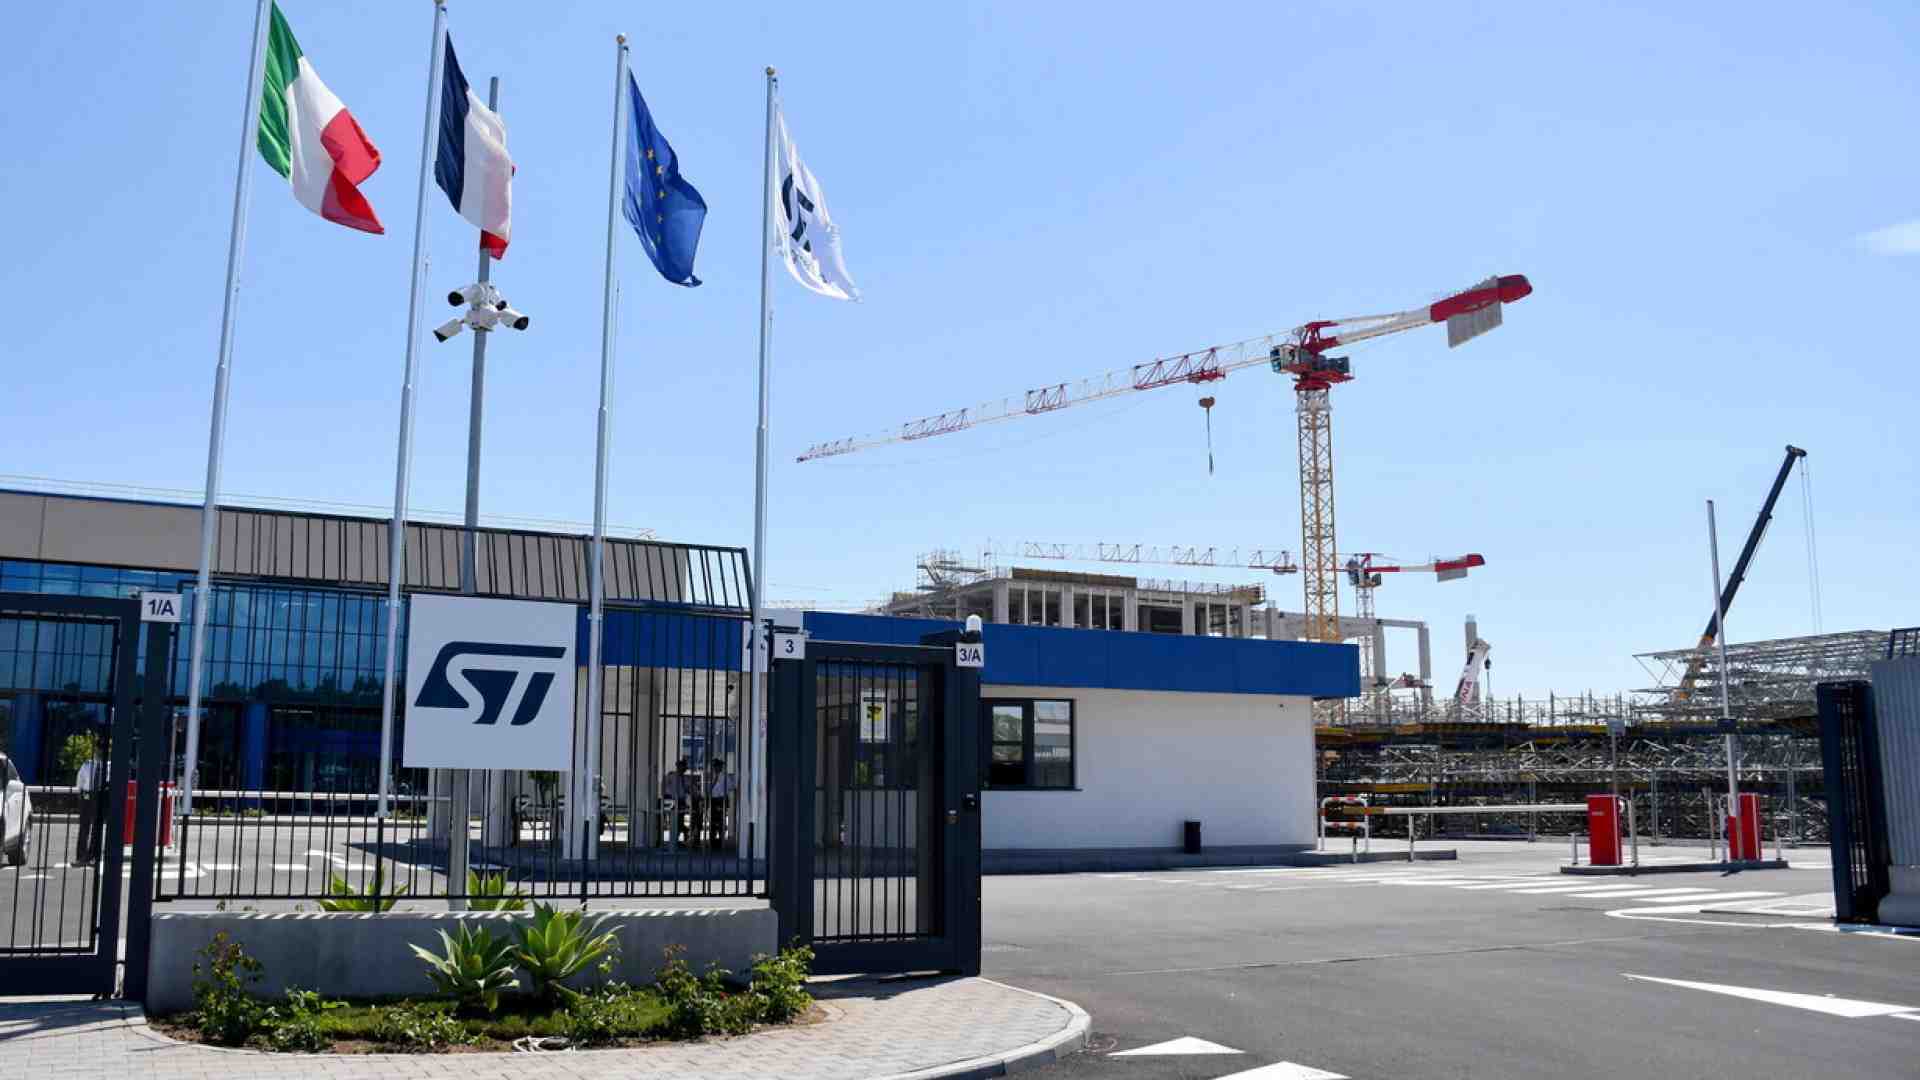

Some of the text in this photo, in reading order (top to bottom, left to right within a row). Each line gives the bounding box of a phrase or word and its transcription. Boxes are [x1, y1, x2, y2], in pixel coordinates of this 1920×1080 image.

[147, 598, 175, 616] 1/A
[784, 638, 795, 654] 3
[959, 646, 982, 662] 3/A
[414, 641, 568, 726] ST
